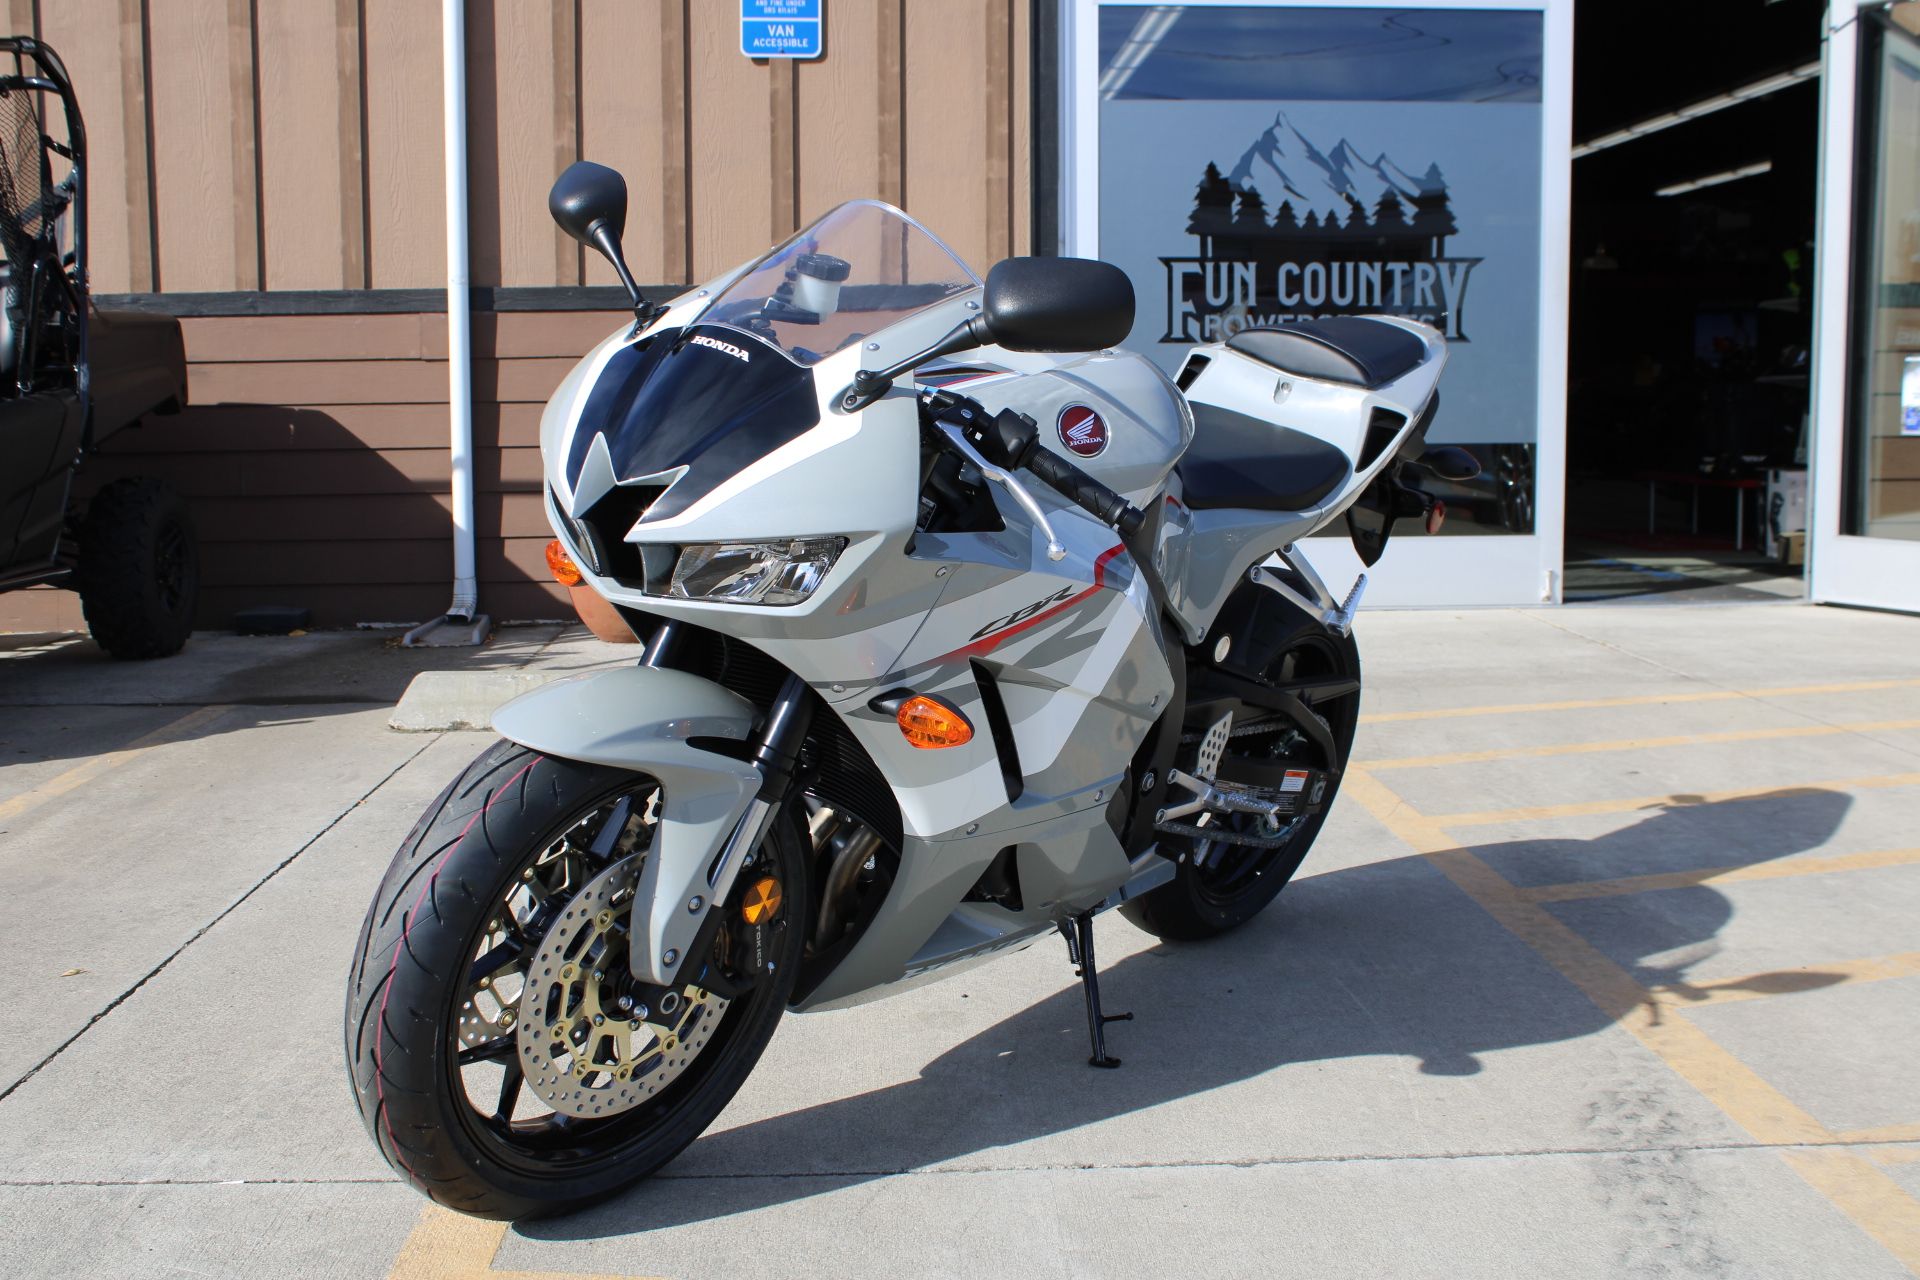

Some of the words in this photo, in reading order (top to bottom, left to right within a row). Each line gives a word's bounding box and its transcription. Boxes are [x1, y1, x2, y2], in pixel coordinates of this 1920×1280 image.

[767, 24, 795, 37] VAN
[753, 38, 809, 48] ACCESSIBLE
[1162, 258, 1258, 341] FUN
[1277, 258, 1478, 341] COUNTRY
[691, 335, 750, 363] HONDA
[1069, 436, 1103, 447] HONDA
[968, 584, 1077, 642] CBR
